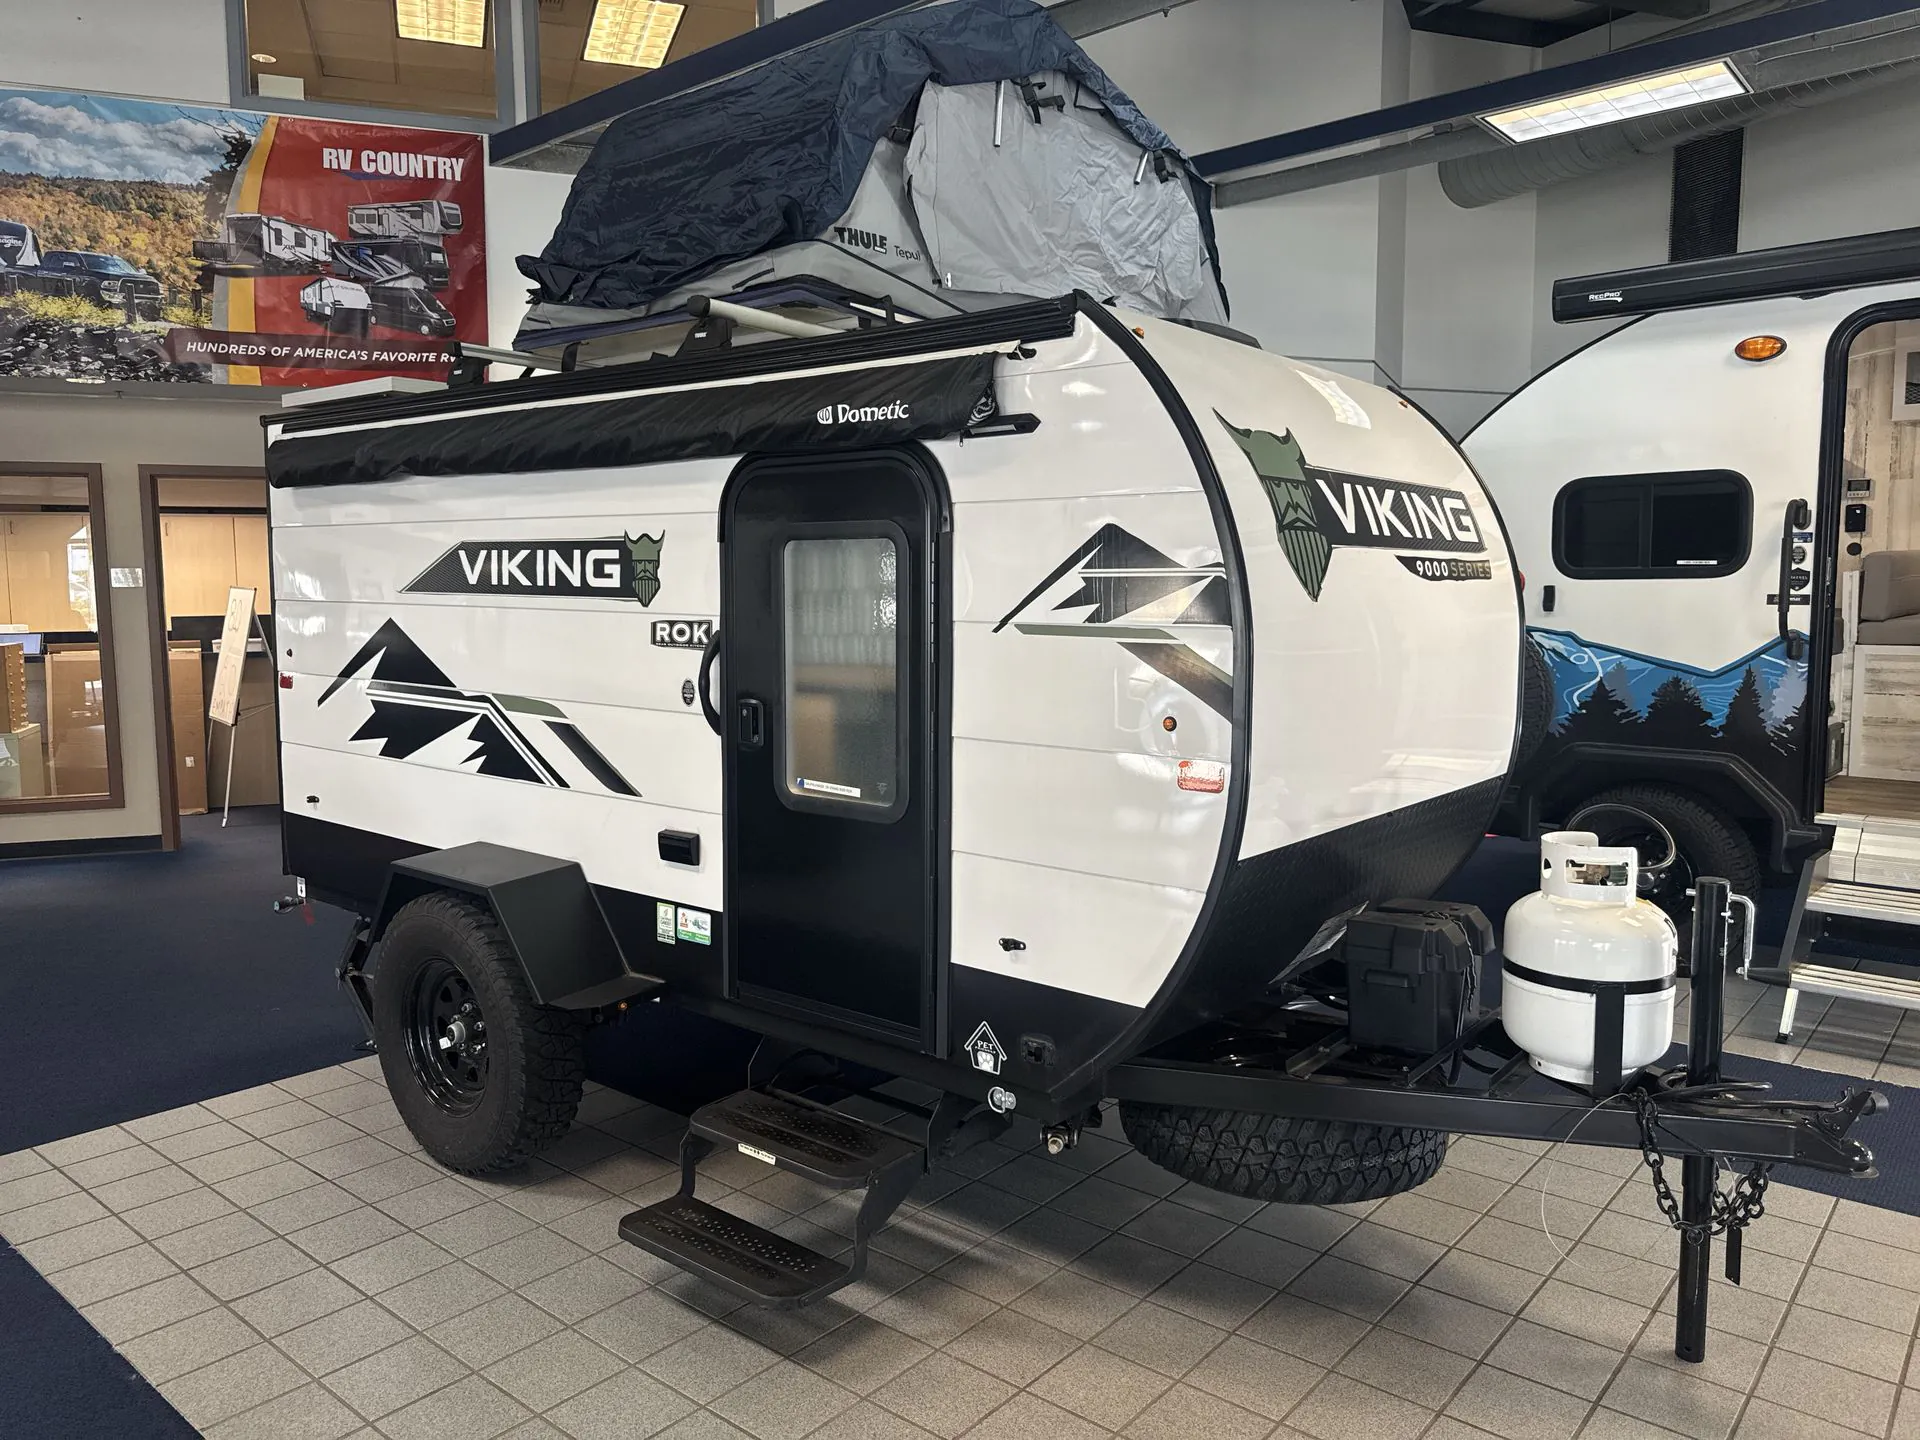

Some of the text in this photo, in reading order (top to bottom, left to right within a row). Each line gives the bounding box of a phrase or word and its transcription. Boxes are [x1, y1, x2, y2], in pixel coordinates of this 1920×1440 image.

[323, 147, 465, 181] RV COUNTRY
[833, 227, 887, 254] THULE
[186, 341, 267, 356] HUNDREDS
[271, 346, 291, 357] OF
[293, 347, 369, 361] AMERICA'S
[372, 351, 438, 363] FAVORITE
[837, 400, 910, 424] Dometic
[1314, 478, 1480, 543] VIKING
[458, 549, 621, 588] VIKING
[1415, 560, 1492, 578] 9000 SERIES
[655, 622, 710, 645] ROK
[977, 1040, 994, 1050] PET
